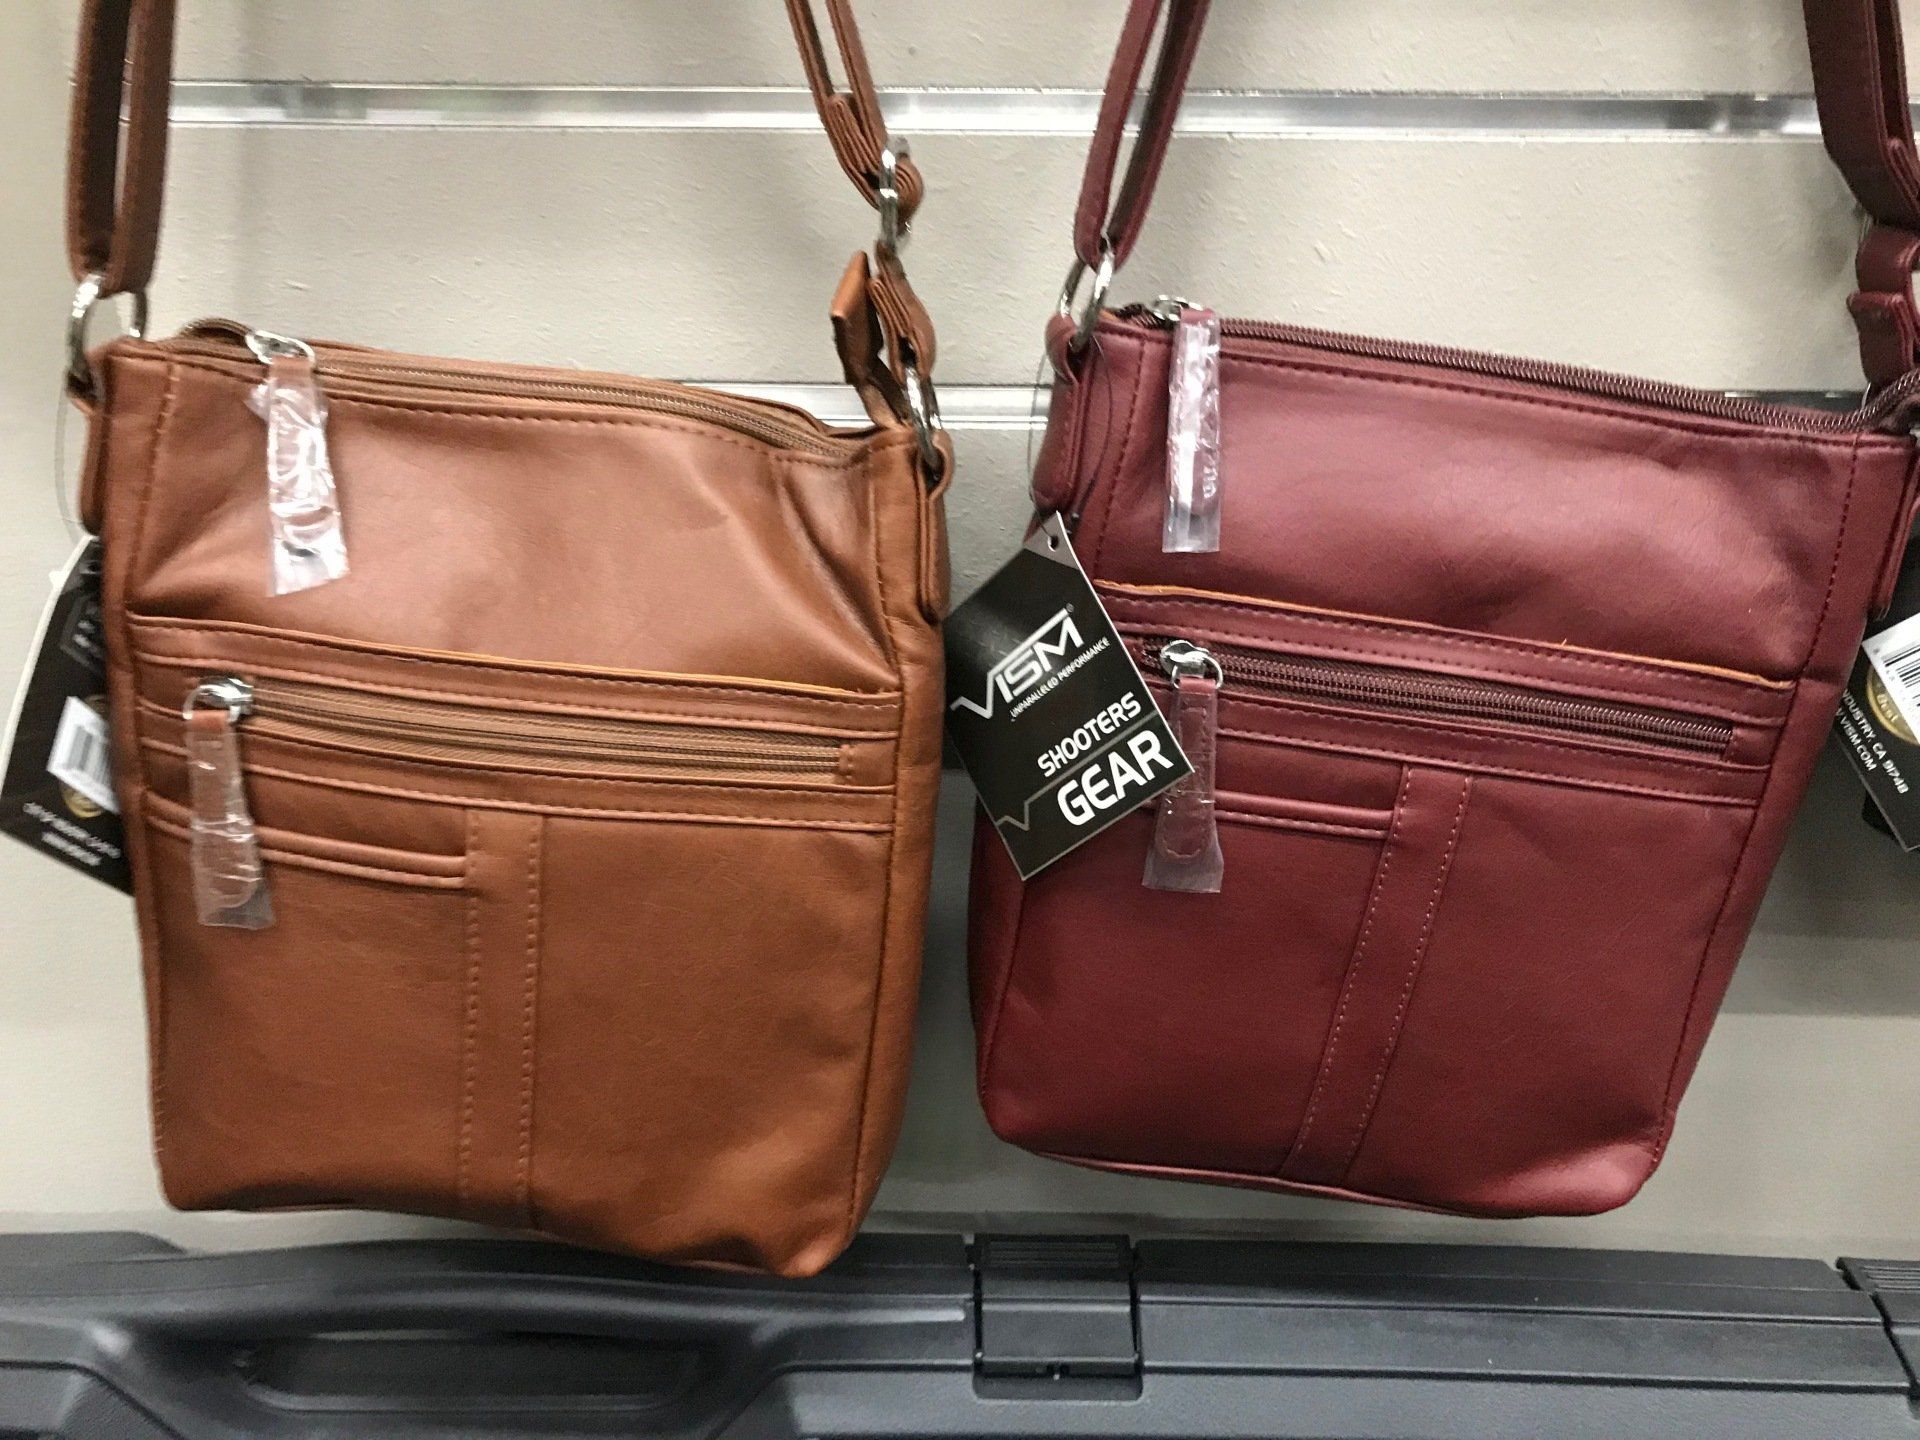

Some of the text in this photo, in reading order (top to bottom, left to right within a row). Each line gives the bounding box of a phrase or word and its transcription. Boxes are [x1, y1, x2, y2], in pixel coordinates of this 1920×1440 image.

[950, 607, 1084, 719] VISM
[1010, 636, 1110, 718] UNPARALLELED PERFORMANCE
[1037, 692, 1142, 778] SHOOTERS
[1057, 729, 1174, 826] GEAR
[1872, 742, 1887, 760] CA
